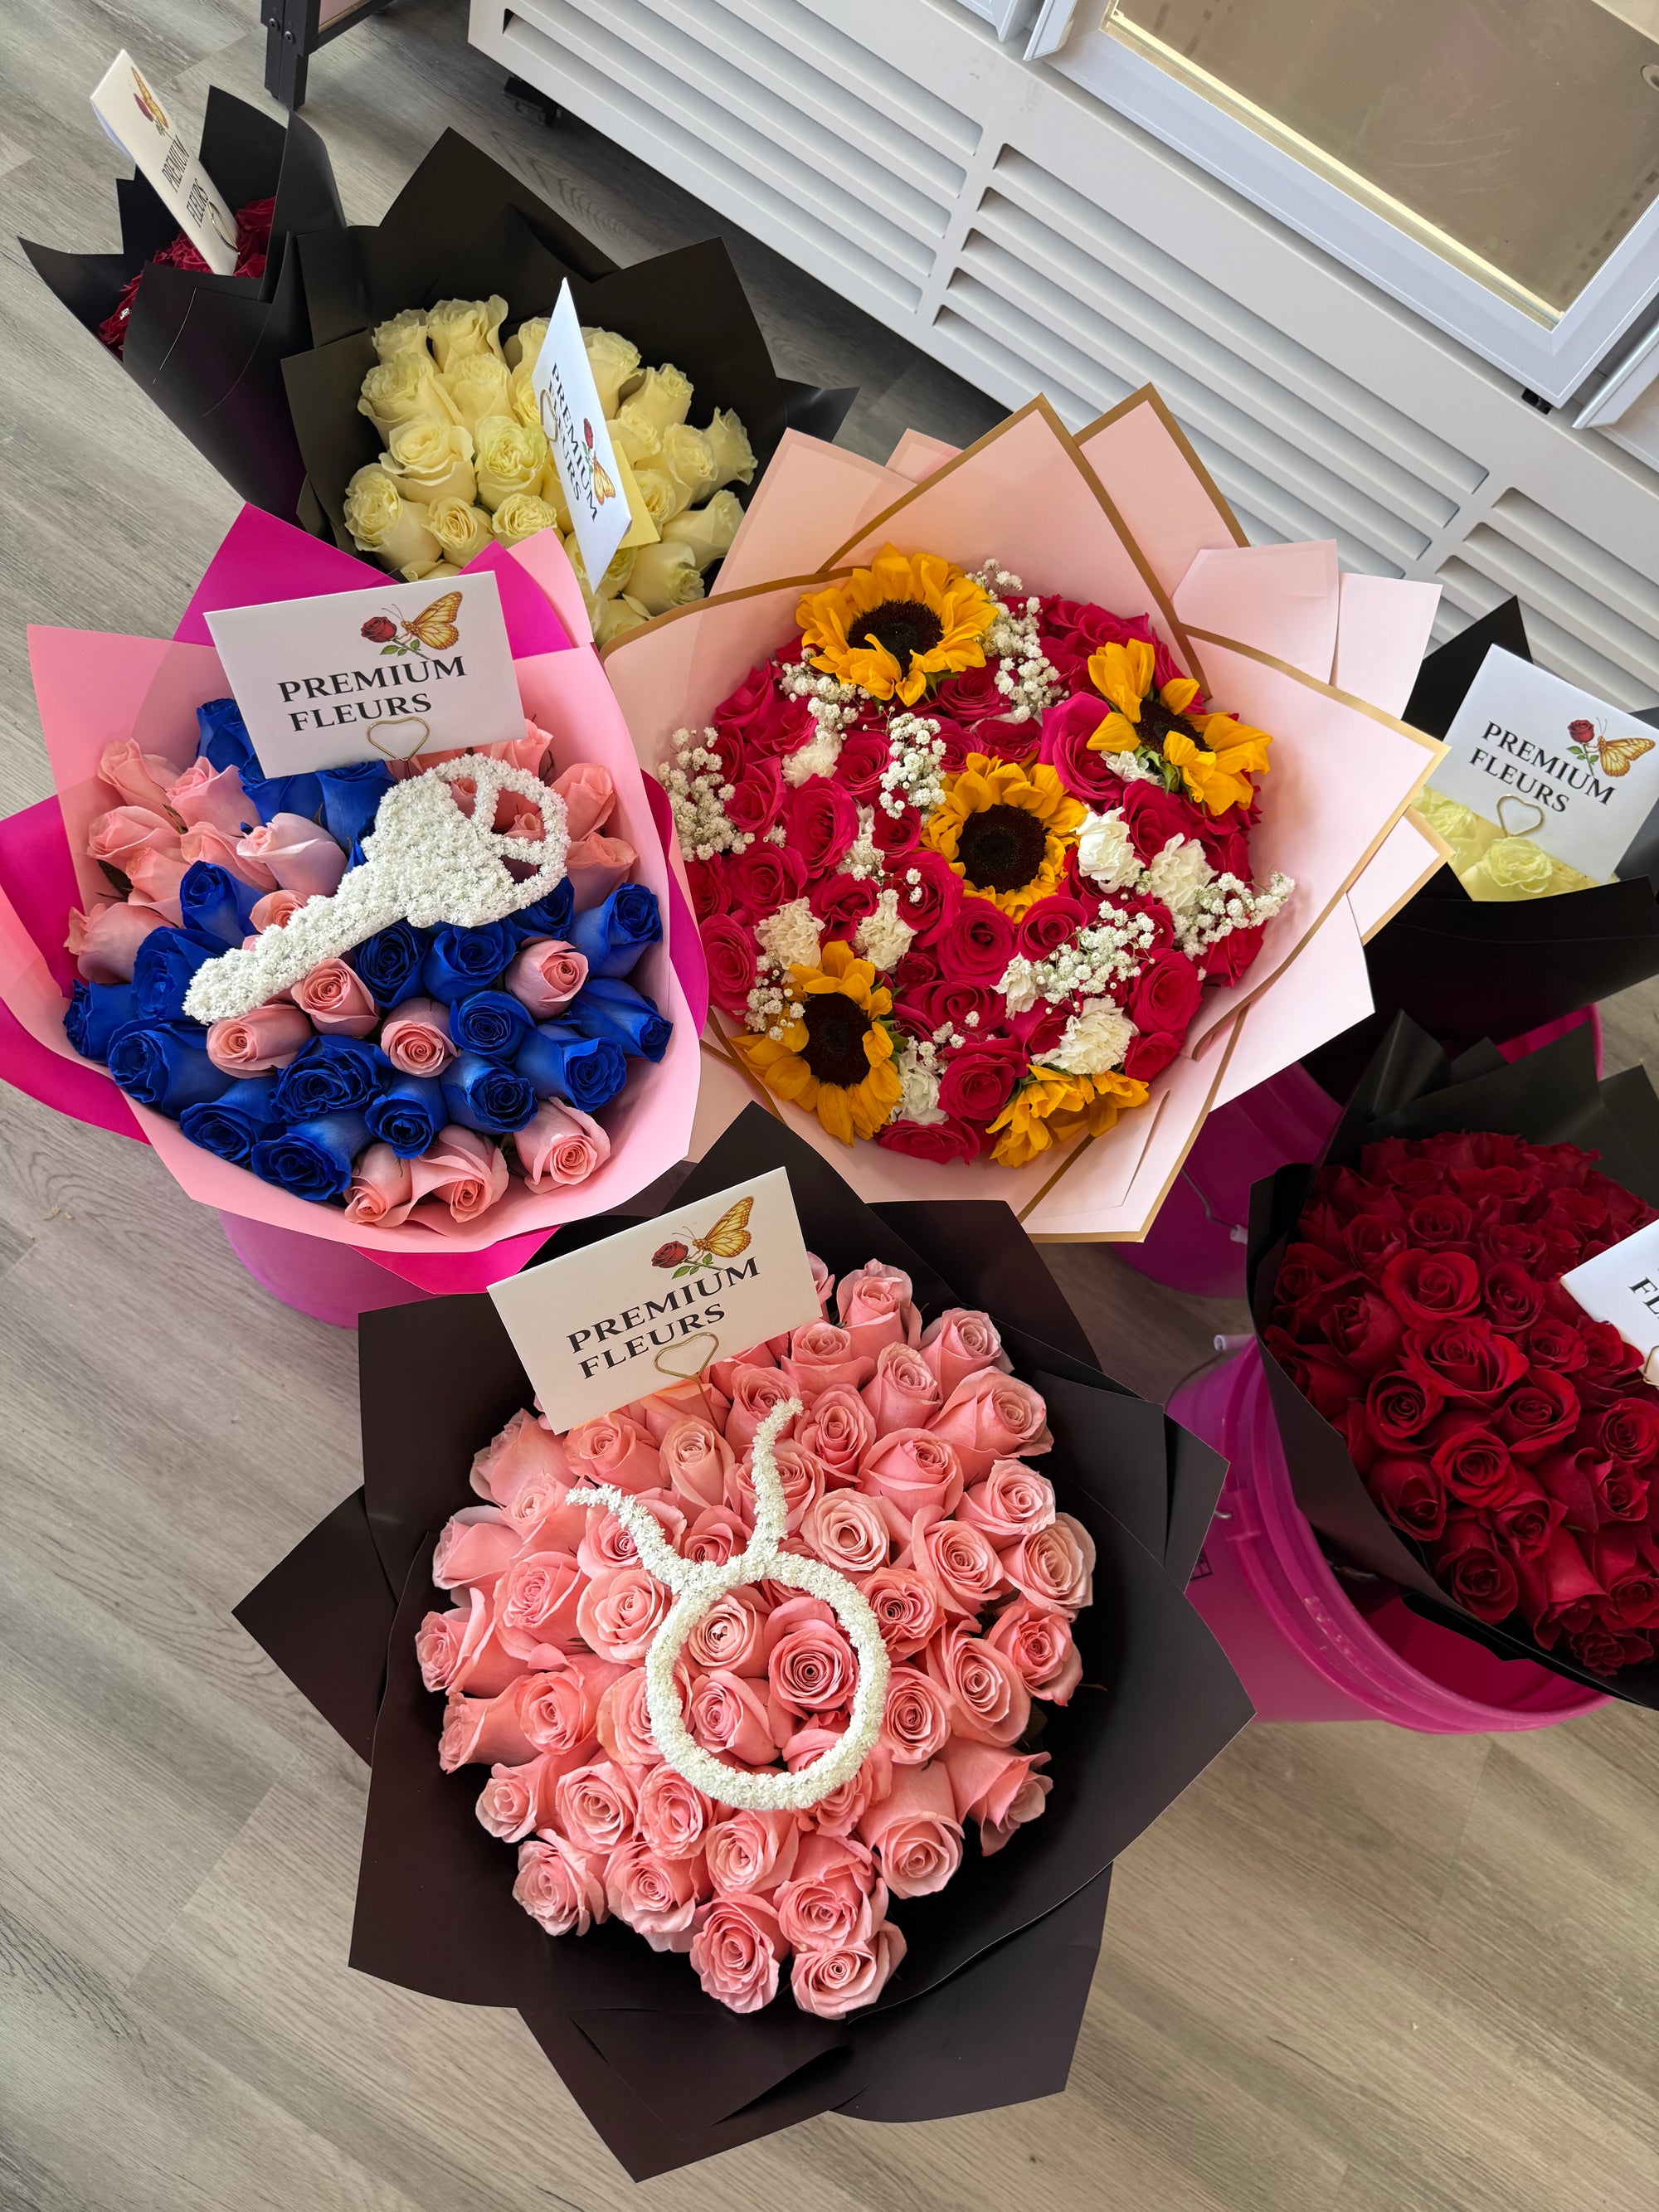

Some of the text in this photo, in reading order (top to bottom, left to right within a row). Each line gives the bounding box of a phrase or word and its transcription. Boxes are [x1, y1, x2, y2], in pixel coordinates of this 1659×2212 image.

[162, 134, 189, 193] PREMIUM
[186, 177, 208, 228] FLEURS
[548, 379, 581, 501] FLEURS
[552, 361, 597, 522] PREMIUM
[277, 656, 467, 703] PREMIUM
[289, 693, 431, 732] FLEURS
[1468, 747, 1569, 813] FLEURS
[1481, 721, 1617, 805] PREMIUM
[566, 1256, 761, 1354] PREMIUM
[1627, 1276, 1659, 1321] FL
[578, 1303, 725, 1380] FLEURS
